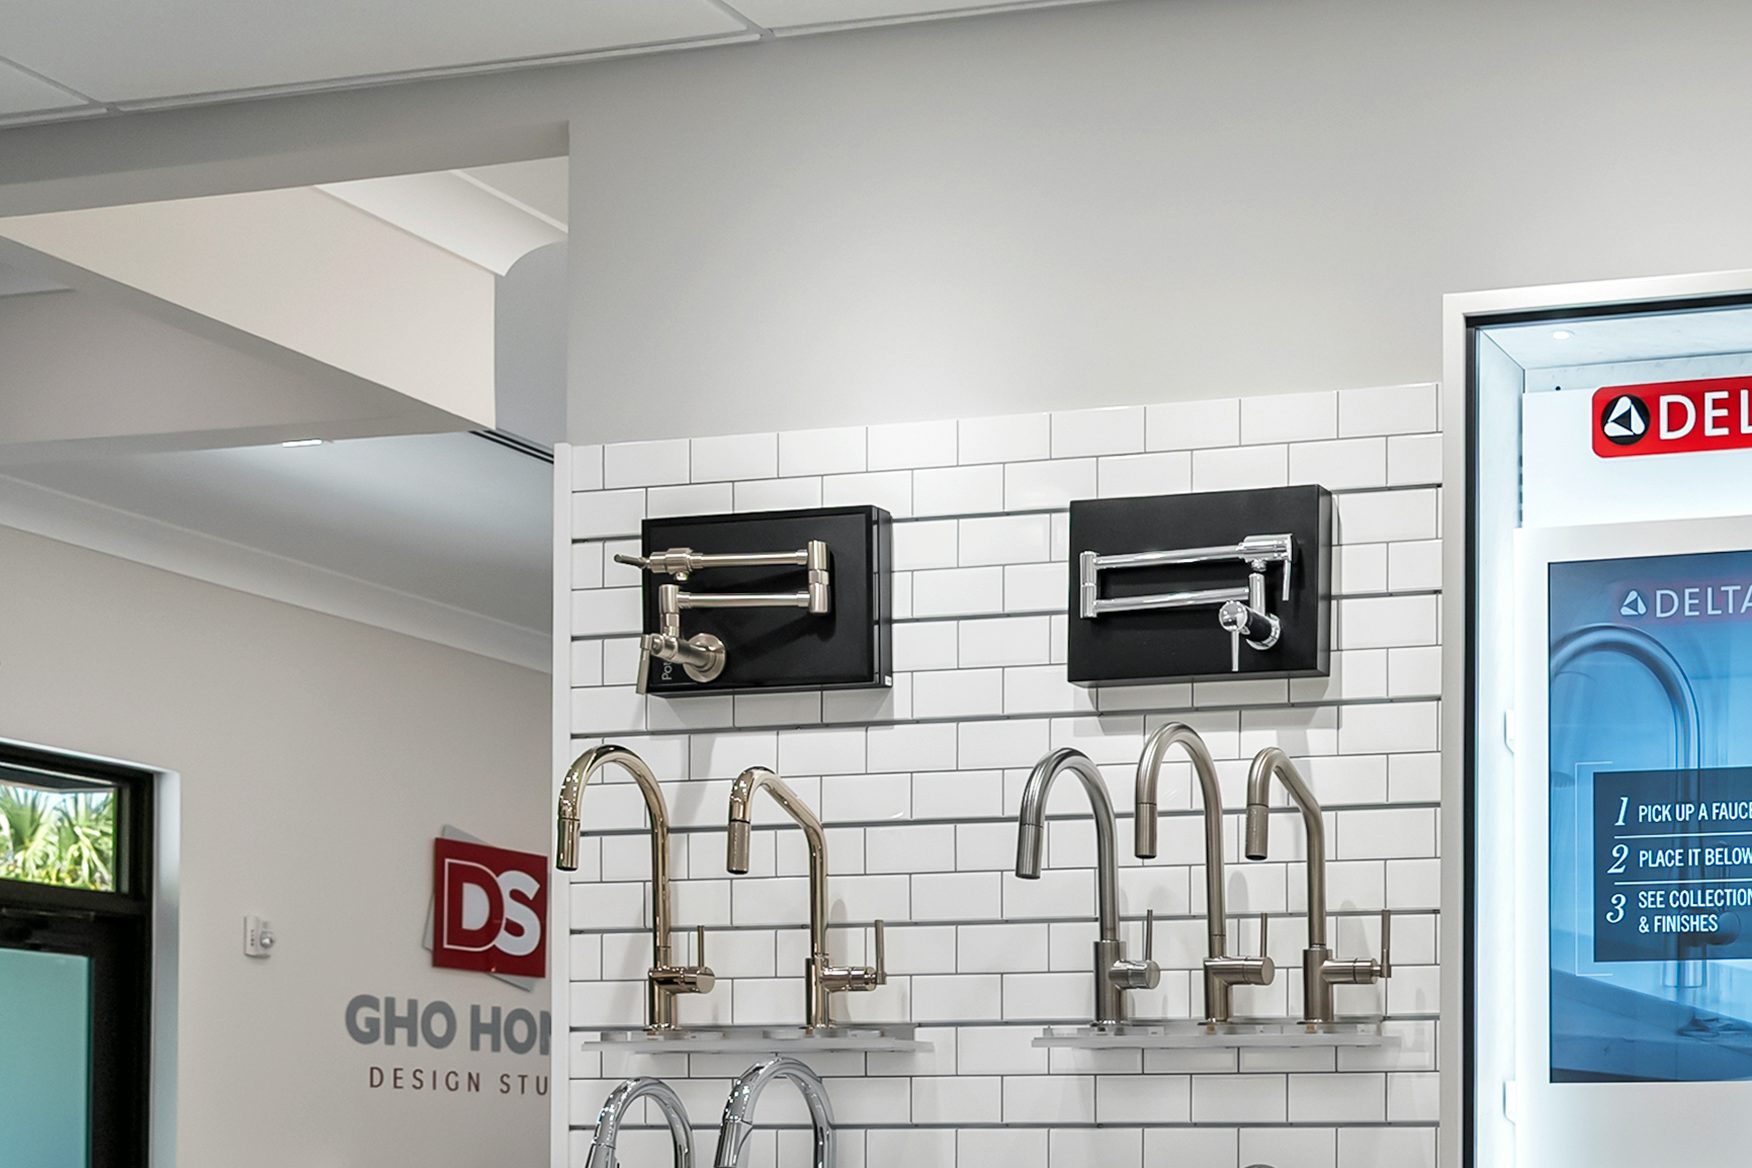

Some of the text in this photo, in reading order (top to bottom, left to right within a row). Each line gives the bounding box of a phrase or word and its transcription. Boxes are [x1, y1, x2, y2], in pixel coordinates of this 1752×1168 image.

[1614, 796, 1629, 826] 1
[1638, 804, 1672, 823] PICK
[1675, 803, 1695, 821] UP
[1698, 803, 1709, 820] A
[1606, 844, 1629, 874] 2
[1639, 849, 1684, 868] PLACE
[1688, 848, 1701, 866] IT
[443, 857, 542, 957] DS
[1606, 893, 1627, 924] 3
[1638, 890, 1666, 909] SEE
[1638, 914, 1719, 934] & FINISHES
[345, 994, 458, 1050] GHO
[369, 1066, 549, 1096] DESIGN STU
